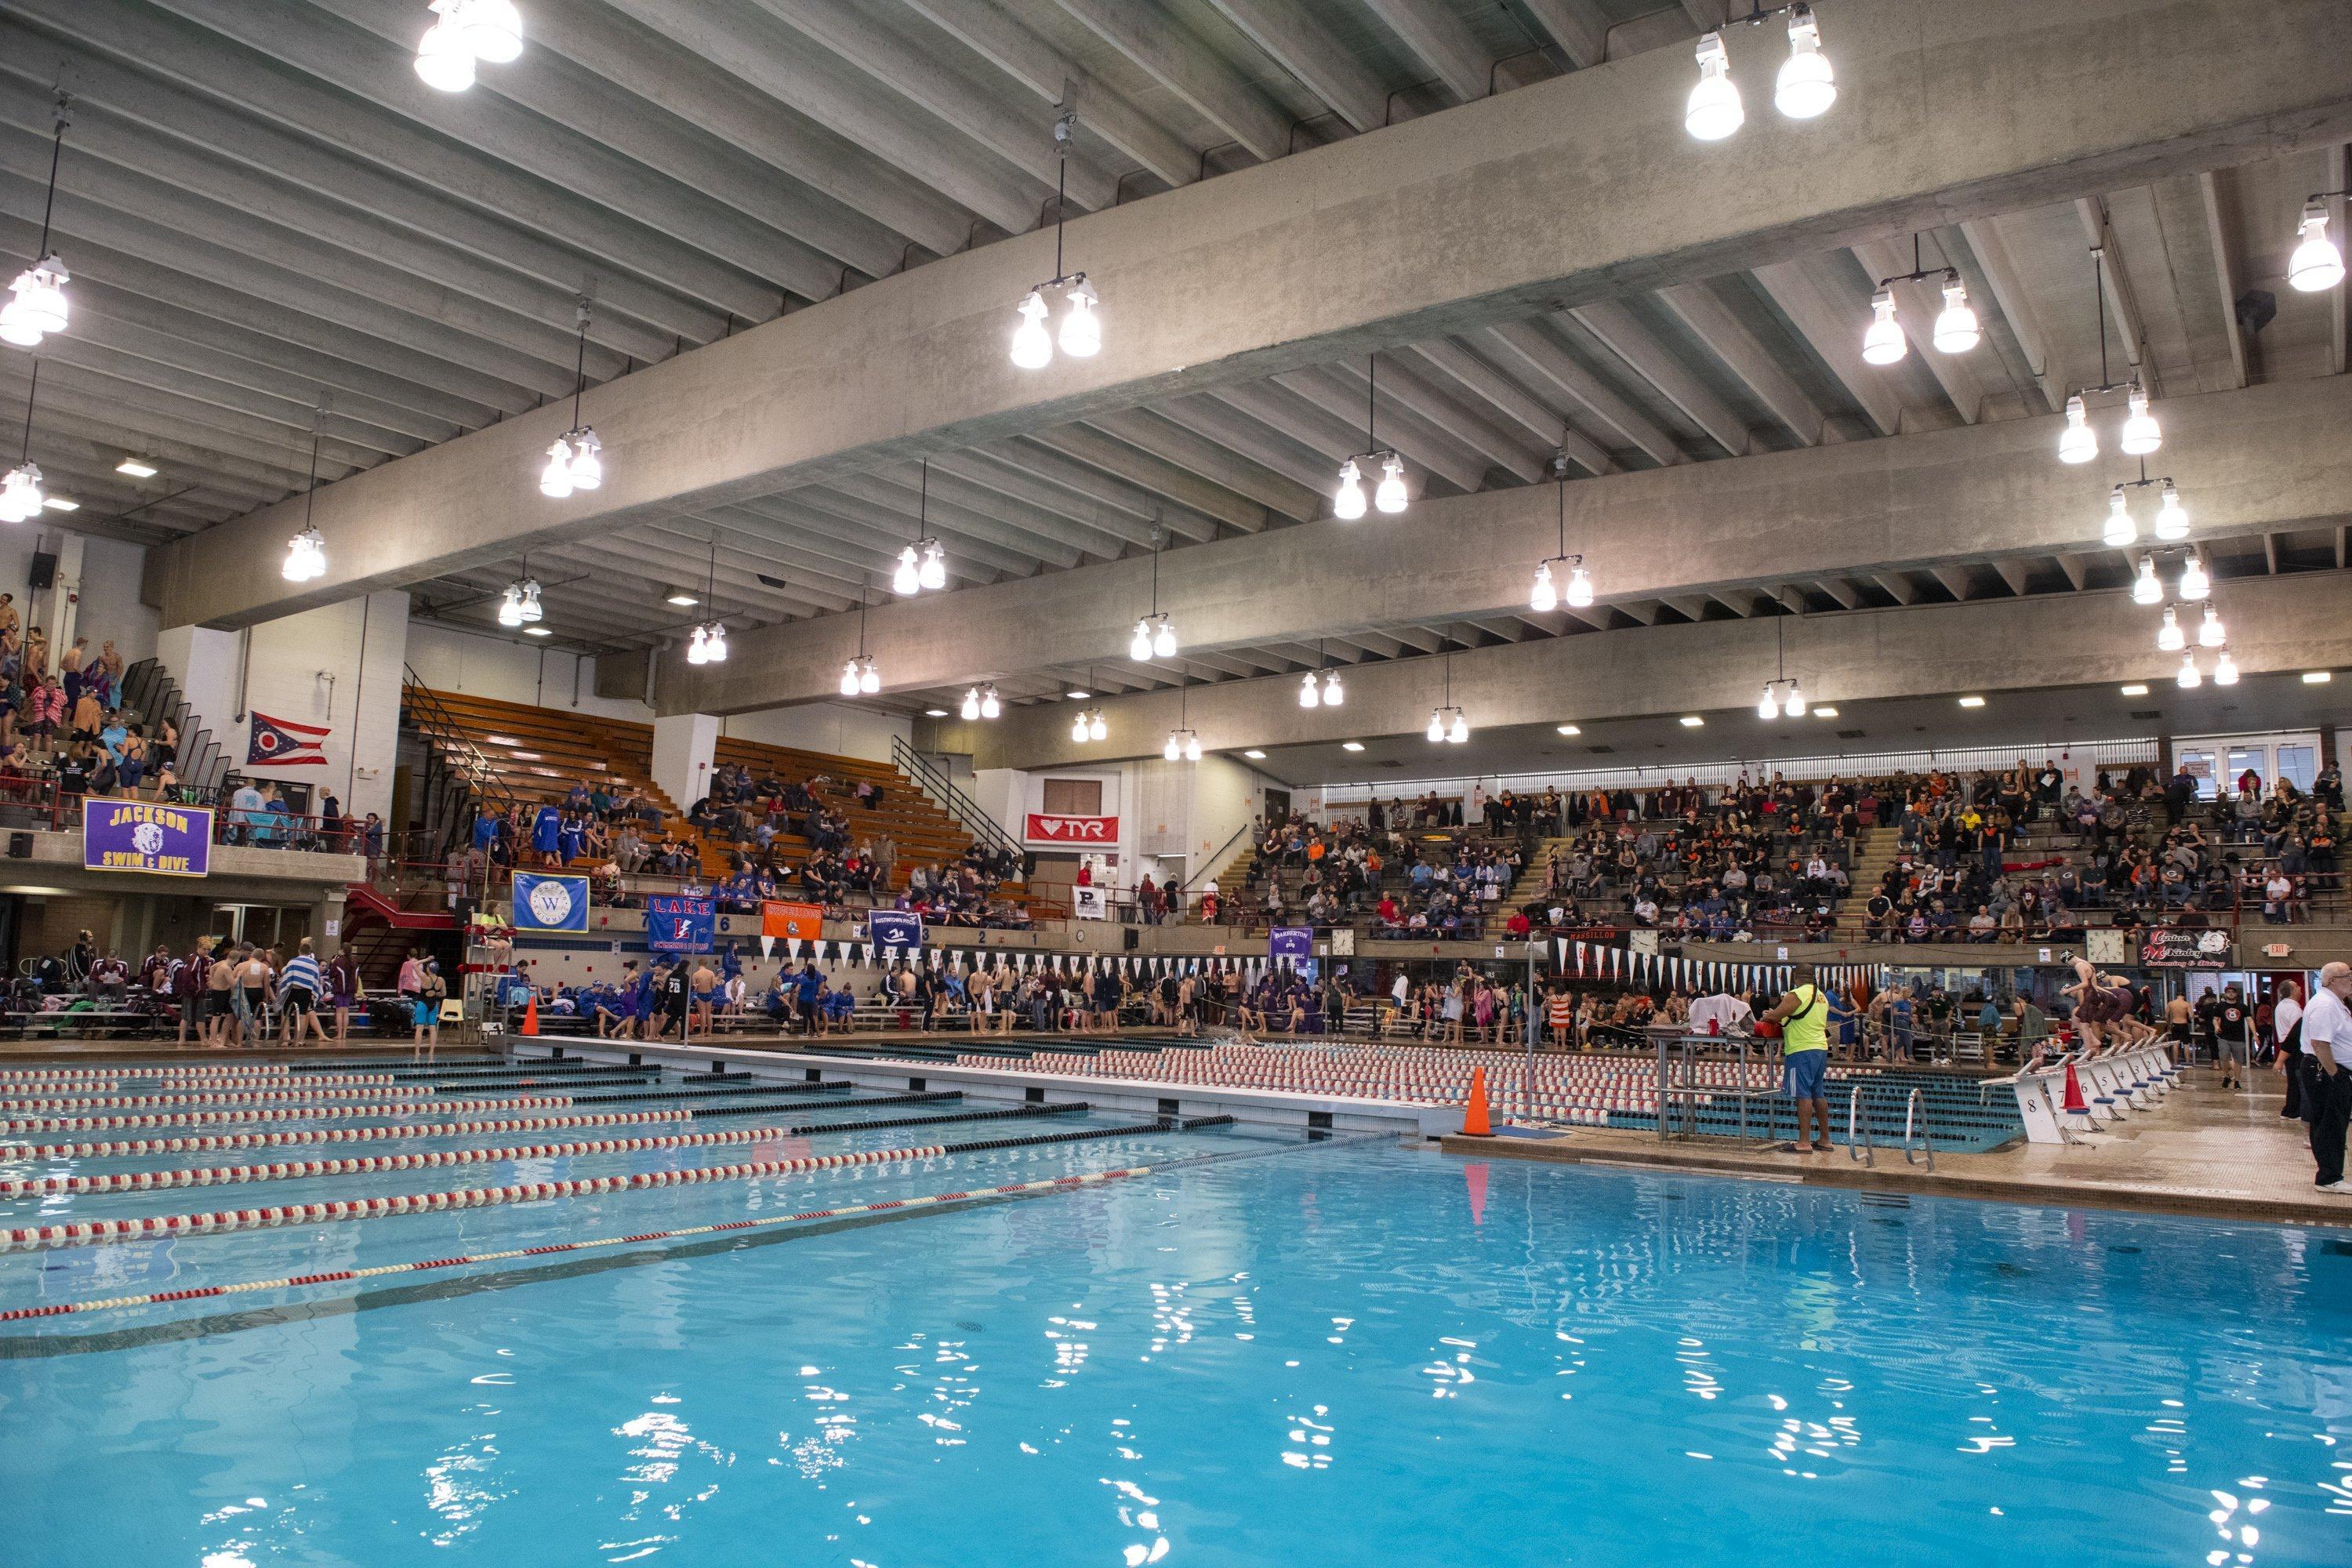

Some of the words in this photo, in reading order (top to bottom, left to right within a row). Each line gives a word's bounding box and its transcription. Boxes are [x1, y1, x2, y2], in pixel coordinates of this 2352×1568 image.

[110, 806, 187, 833] JACKSON
[1065, 820, 1105, 838] TYR
[103, 851, 144, 866] SWIM
[147, 857, 155, 869] &
[158, 855, 190, 872] DIVE
[542, 897, 559, 911] W
[654, 898, 710, 916] LAKE
[641, 913, 649, 927] 7
[720, 916, 731, 931] 6
[860, 925, 869, 938] 4
[922, 927, 929, 941] 3
[978, 931, 985, 943] 2
[1570, 931, 1615, 940] MASSILLON
[2150, 931, 2191, 945] Canton
[1033, 933, 1036, 946] 1
[2142, 946, 2202, 960] McKinley
[2272, 944, 2284, 953] EXIT
[2197, 960, 2226, 968] Diving
[2134, 1065, 2140, 1075] 3
[2147, 1062, 2151, 1070] 2
[2102, 1076, 2107, 1087] 5
[2118, 1071, 2125, 1080] 4
[2082, 1082, 2088, 1094] 6
[2058, 1091, 2064, 1103] 7
[2028, 1099, 2036, 1112] 8
